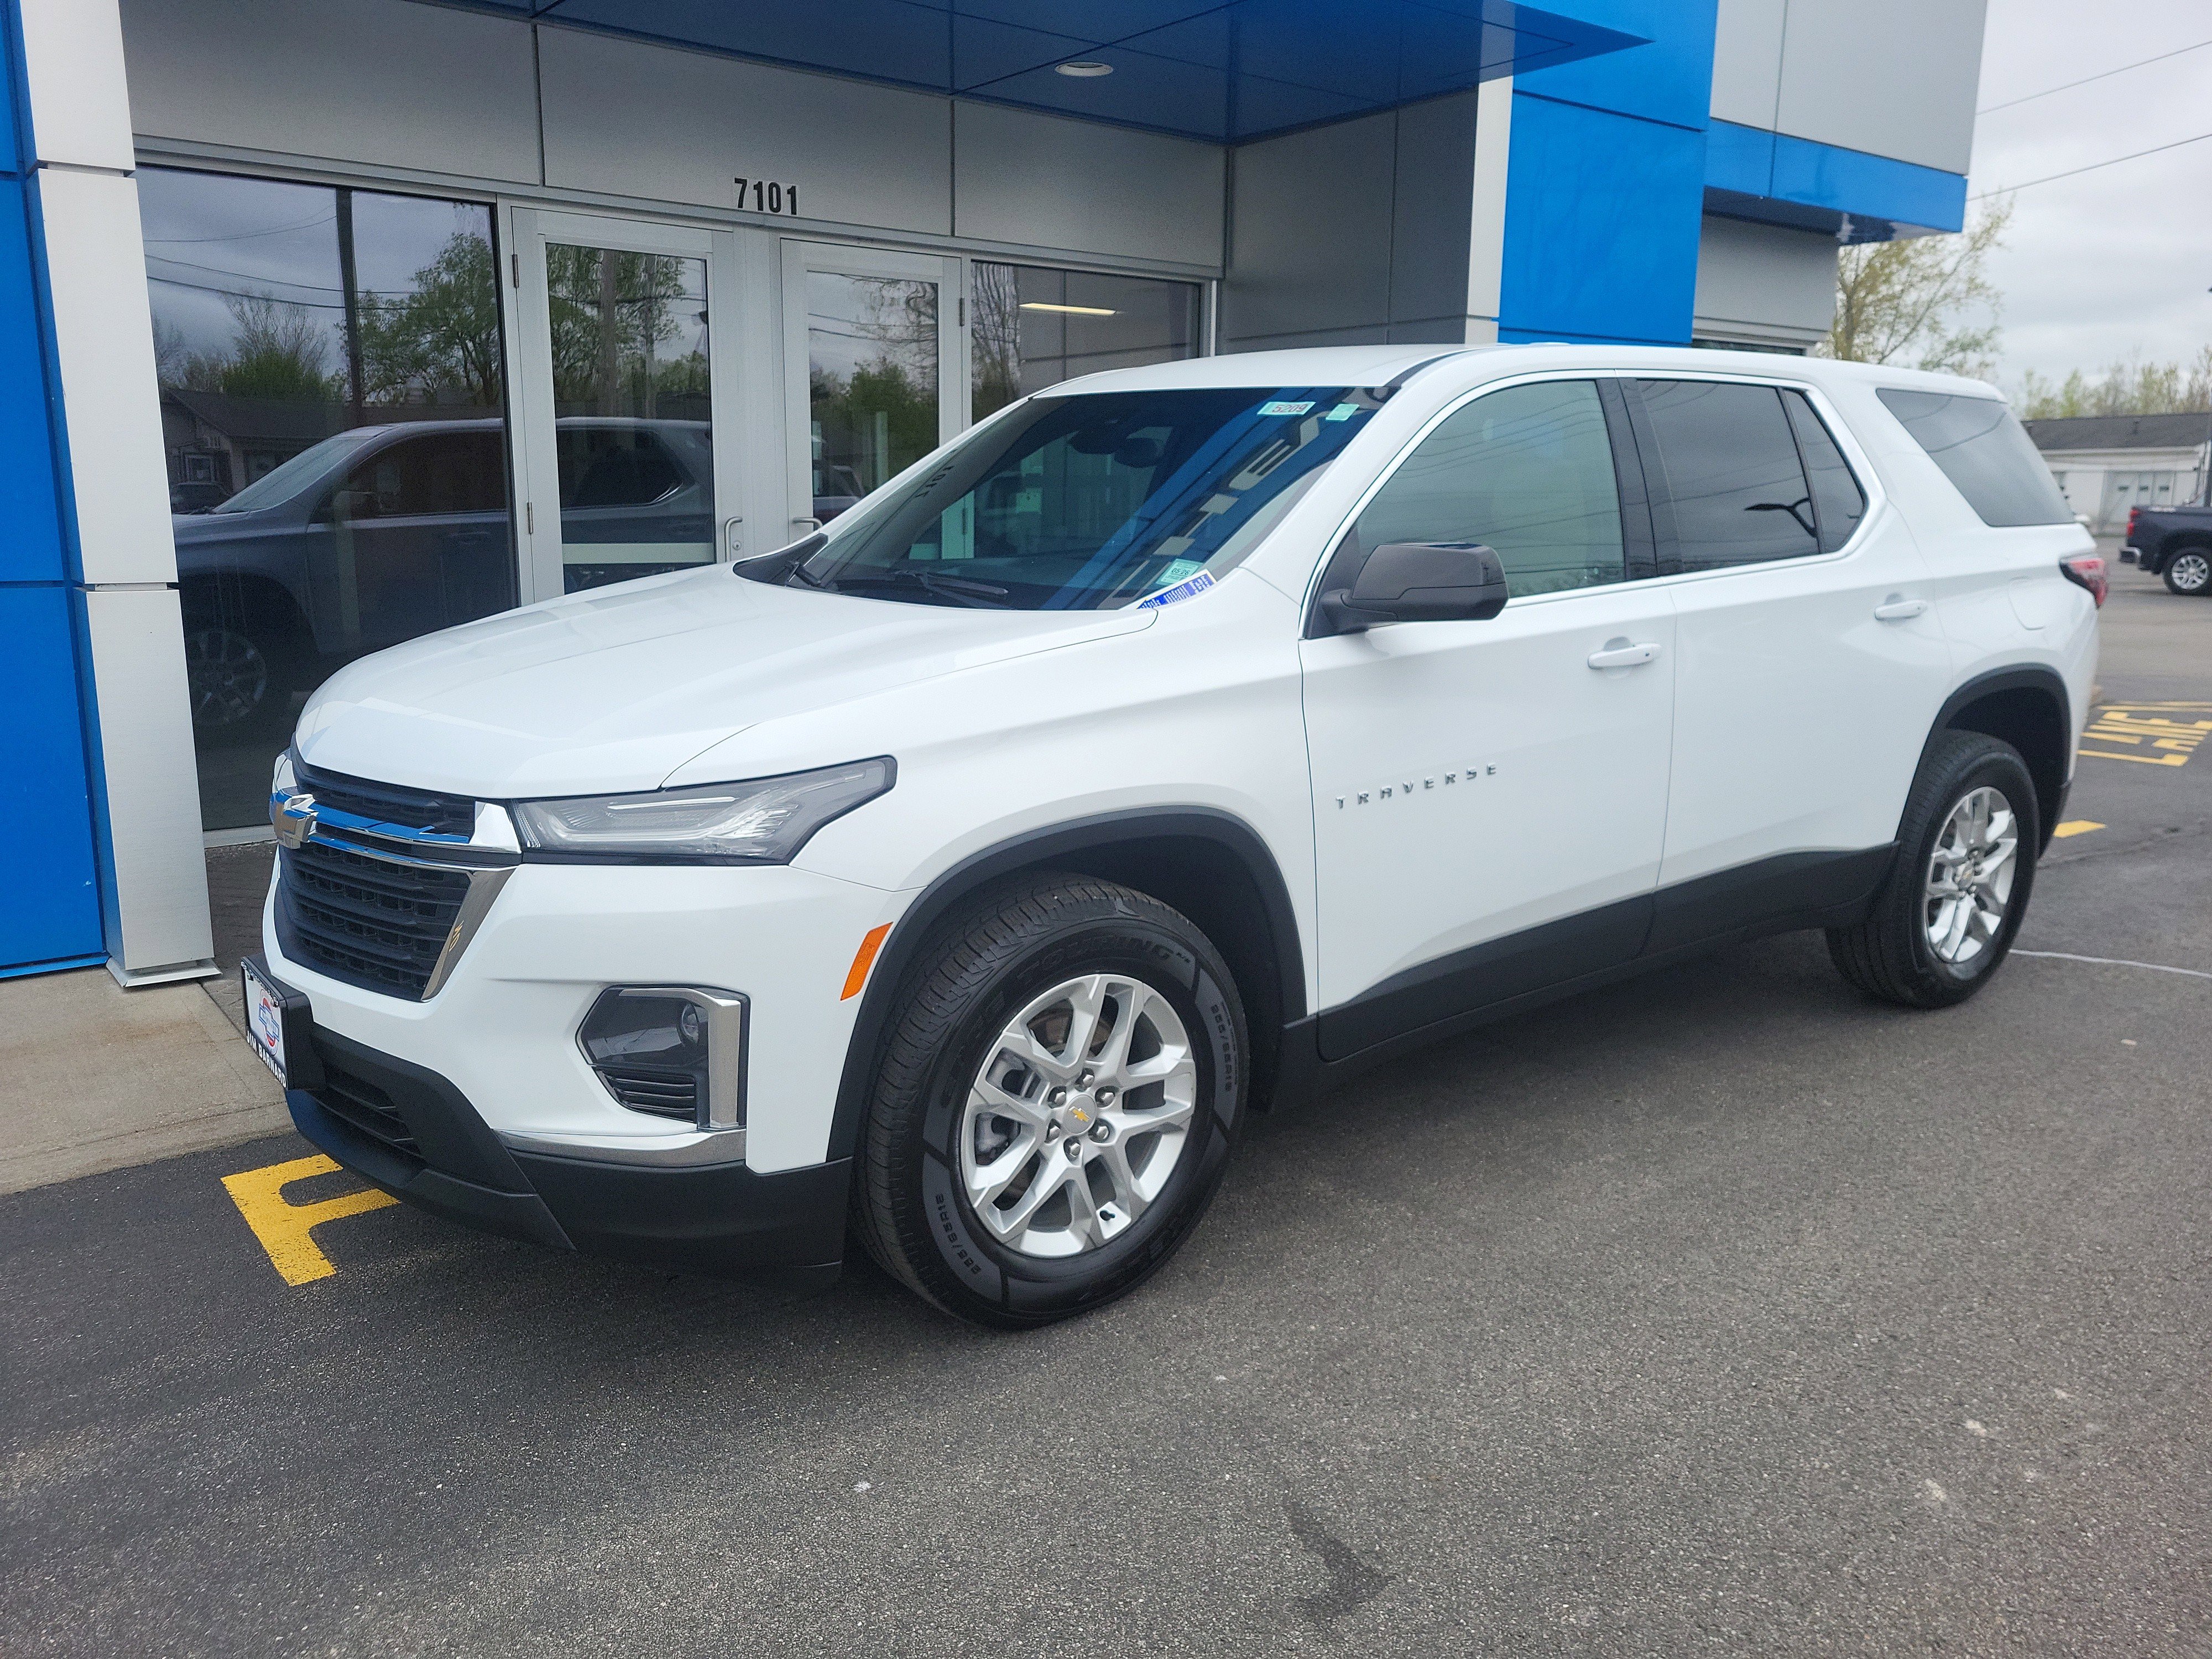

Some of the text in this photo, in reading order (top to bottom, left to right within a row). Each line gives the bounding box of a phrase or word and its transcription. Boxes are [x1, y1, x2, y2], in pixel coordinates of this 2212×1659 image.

[734, 177, 797, 216] 7101
[1272, 404, 1308, 413] 5209
[1335, 763, 1496, 809] TRAVERSE
[246, 1030, 257, 1052] JIM
[258, 1042, 286, 1088] BARNARD
